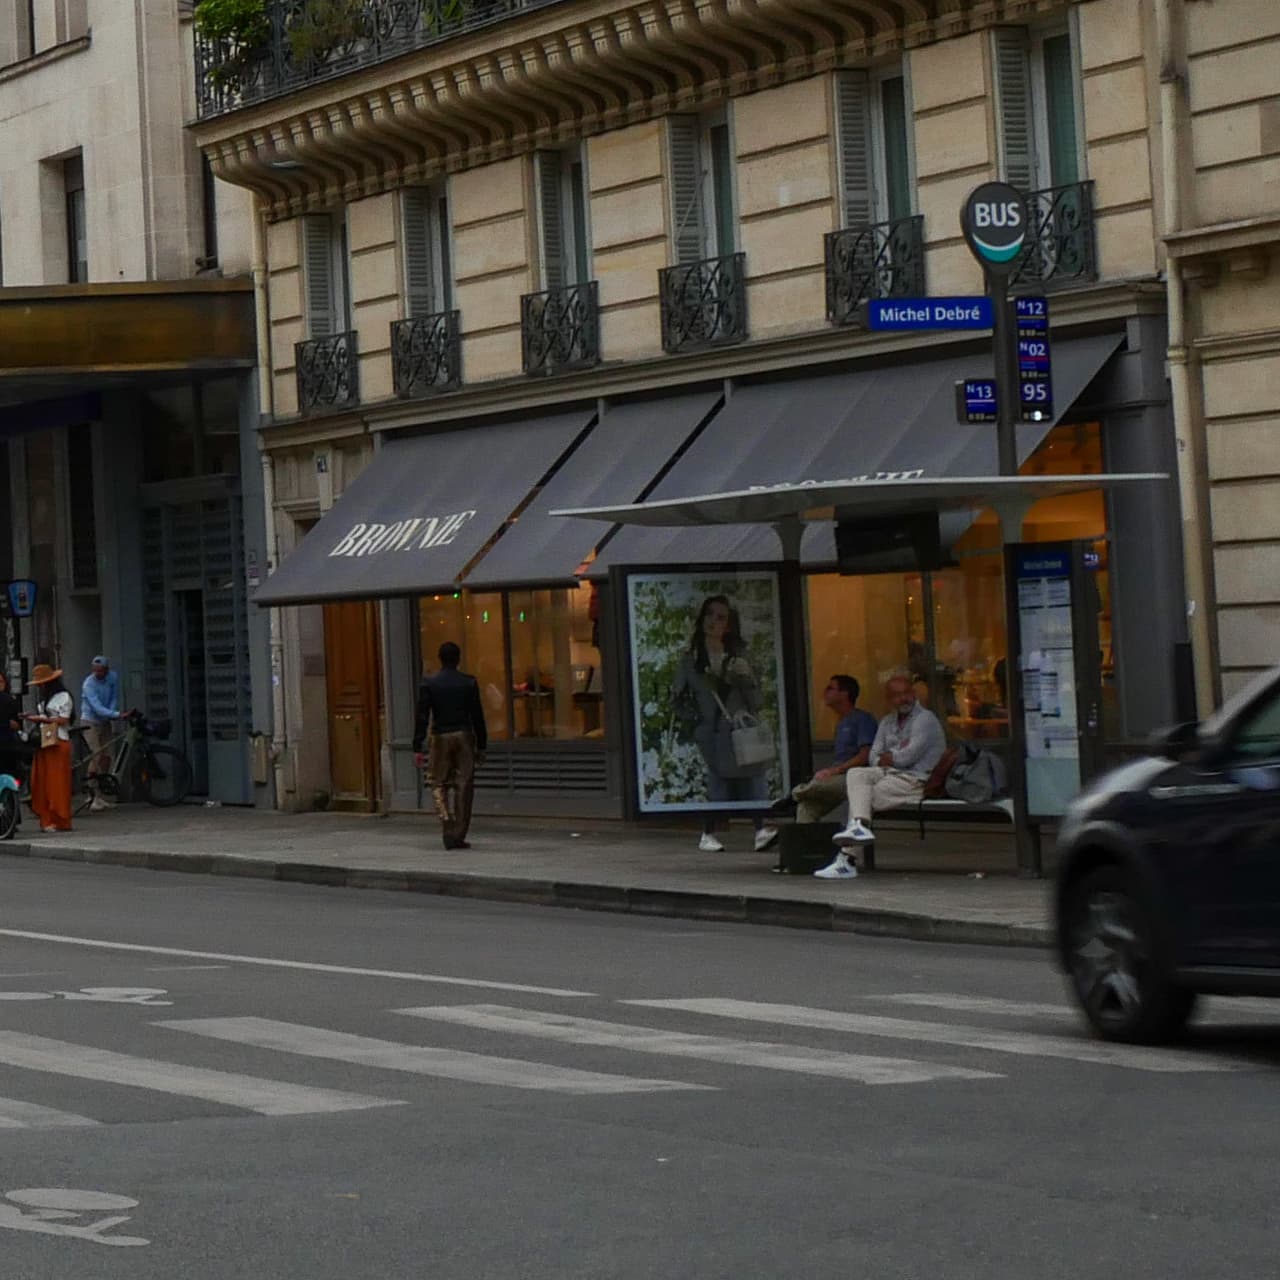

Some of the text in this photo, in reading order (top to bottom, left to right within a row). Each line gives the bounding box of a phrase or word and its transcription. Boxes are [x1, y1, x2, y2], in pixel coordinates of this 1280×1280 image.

[974, 202, 1021, 227] BUS
[880, 304, 981, 322] Michel Debré
[1023, 383, 1047, 400] 95
[328, 509, 477, 559] BROWNIE
